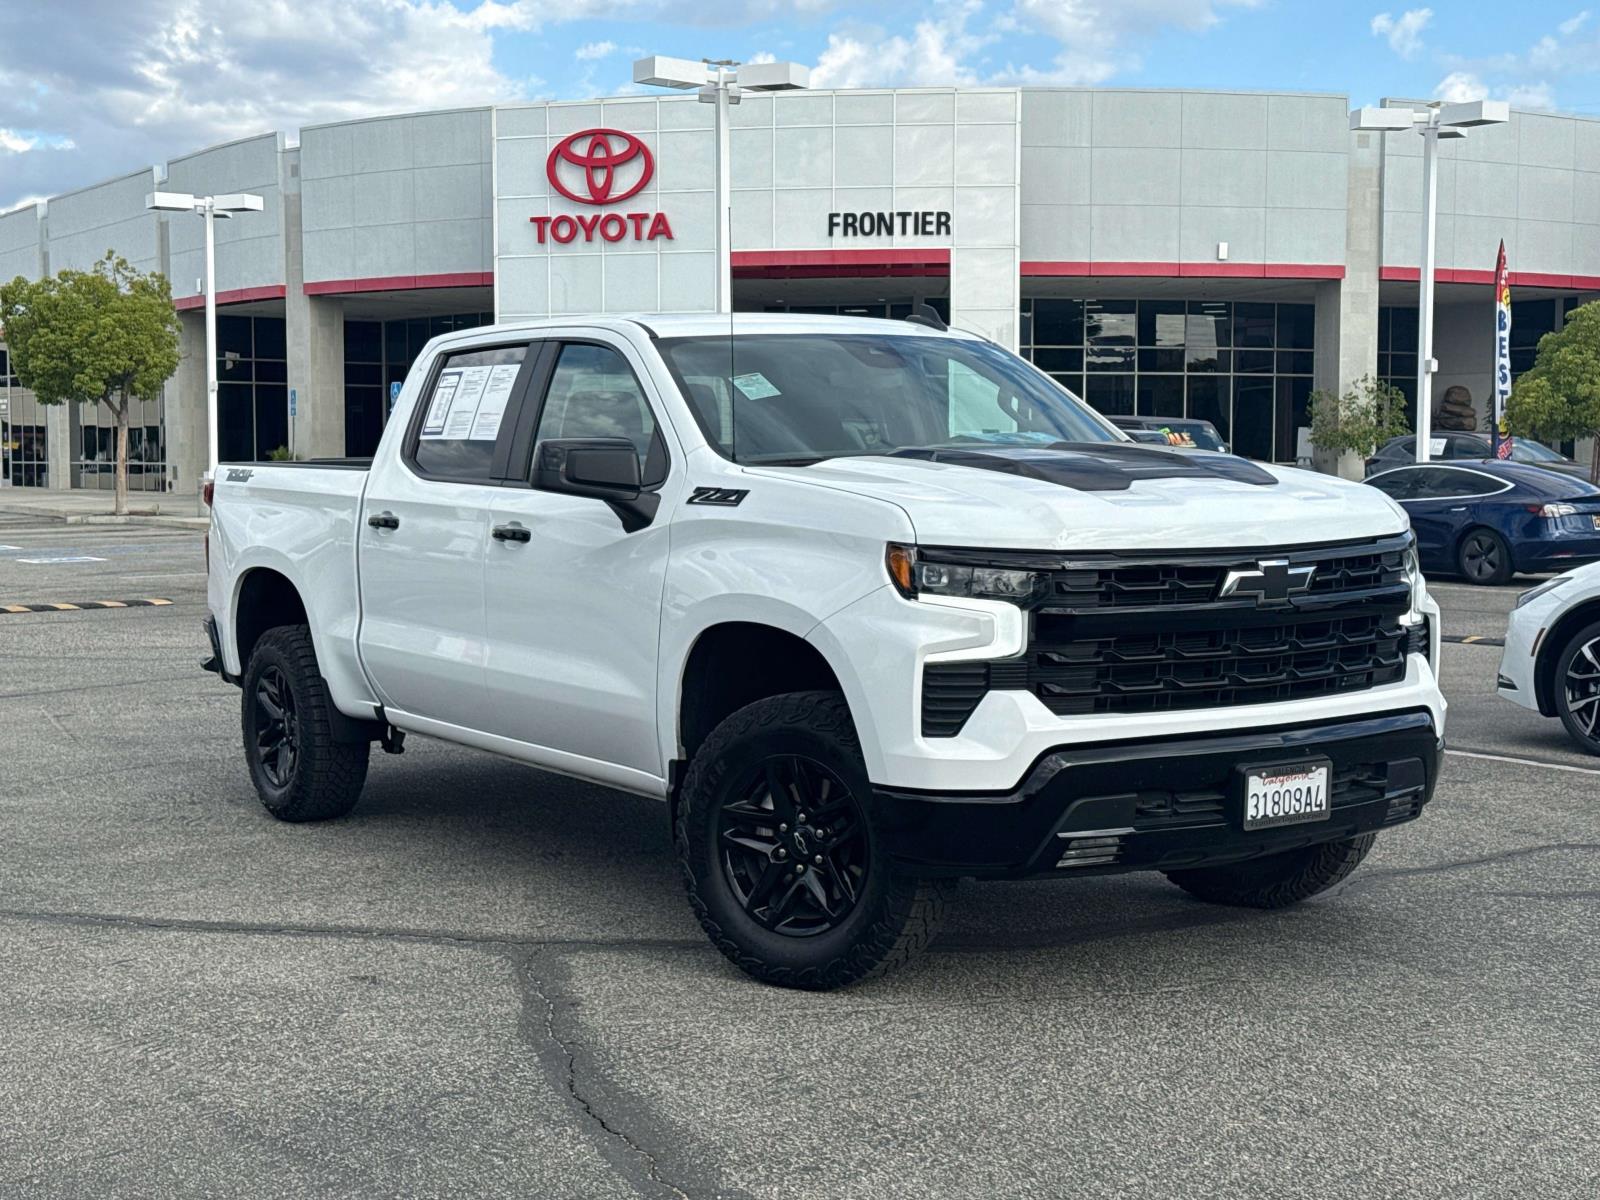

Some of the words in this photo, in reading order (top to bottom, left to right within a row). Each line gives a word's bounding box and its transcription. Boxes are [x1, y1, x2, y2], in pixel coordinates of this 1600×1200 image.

[530, 212, 674, 244] TOYOTA
[827, 211, 952, 237] FRONTIER
[1497, 309, 1510, 412] BEST
[1249, 785, 1324, 820] 31809A4
